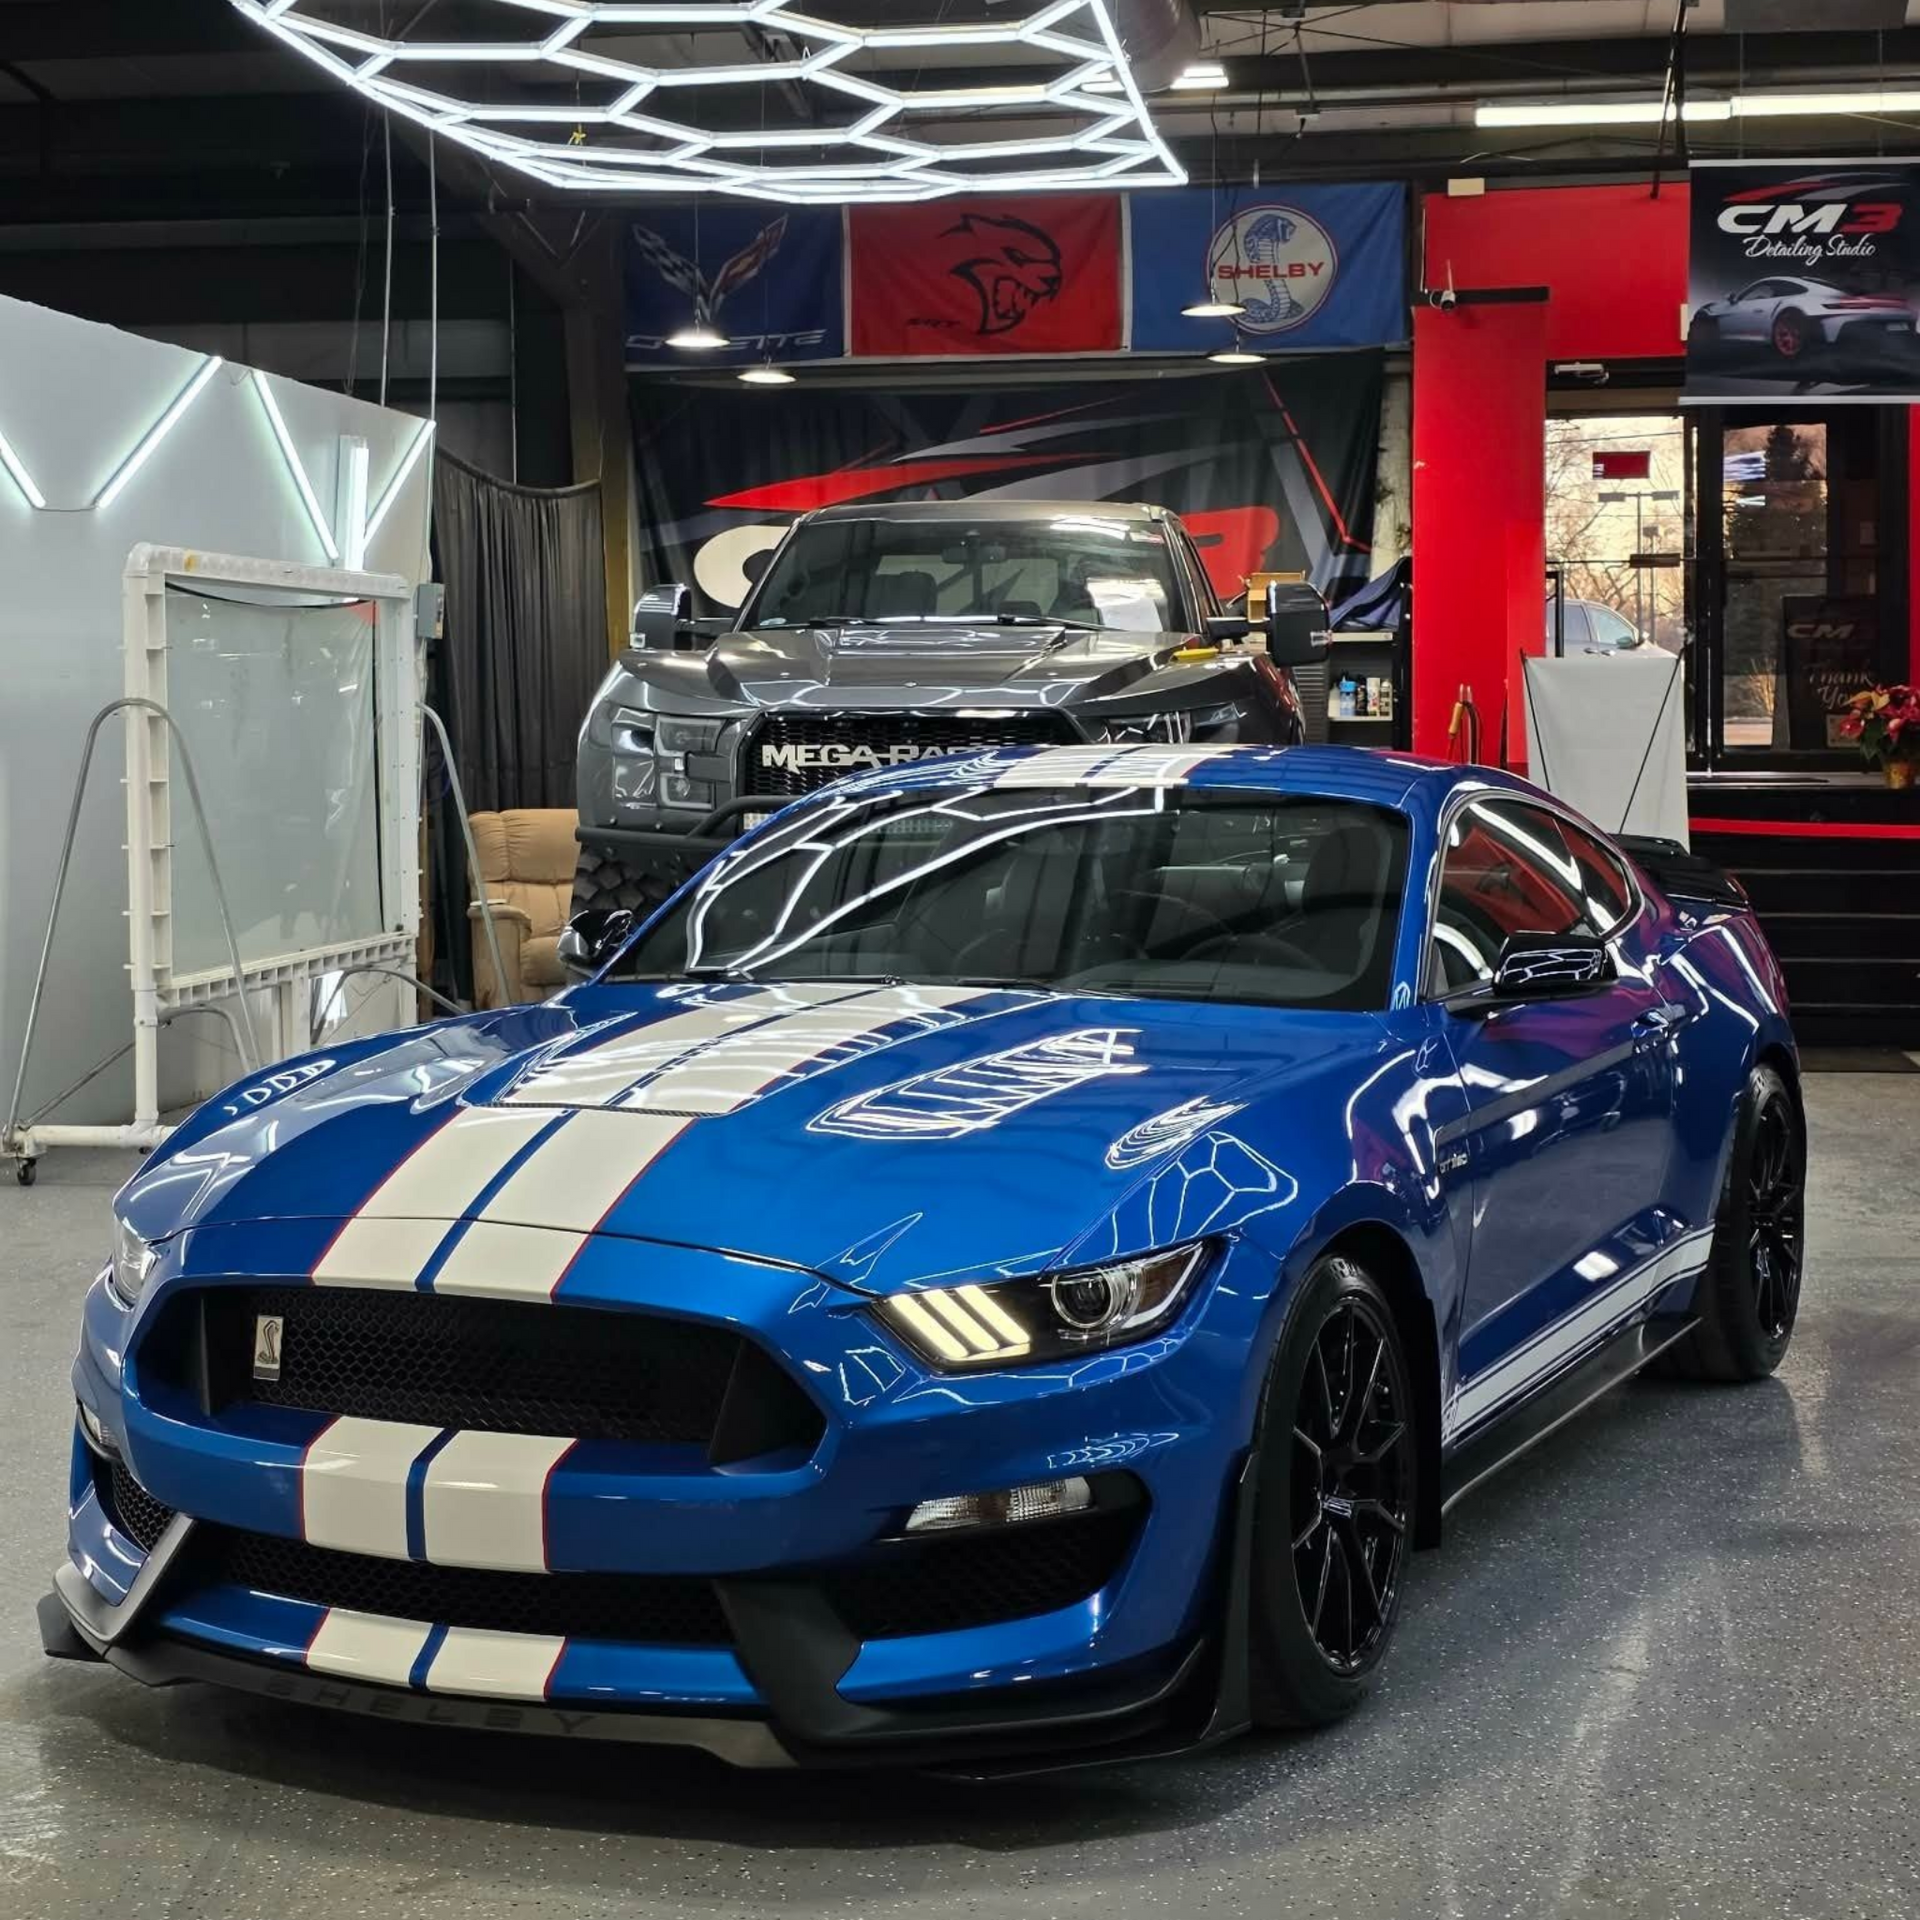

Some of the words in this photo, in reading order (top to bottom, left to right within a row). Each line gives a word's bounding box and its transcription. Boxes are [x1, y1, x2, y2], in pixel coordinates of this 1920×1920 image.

[1717, 203, 1904, 233] CM3
[1742, 234, 1823, 266] Detailing
[1826, 233, 1877, 258] Studio
[1217, 261, 1325, 280] SHELBY
[264, 1673, 598, 1735] SHELBY
